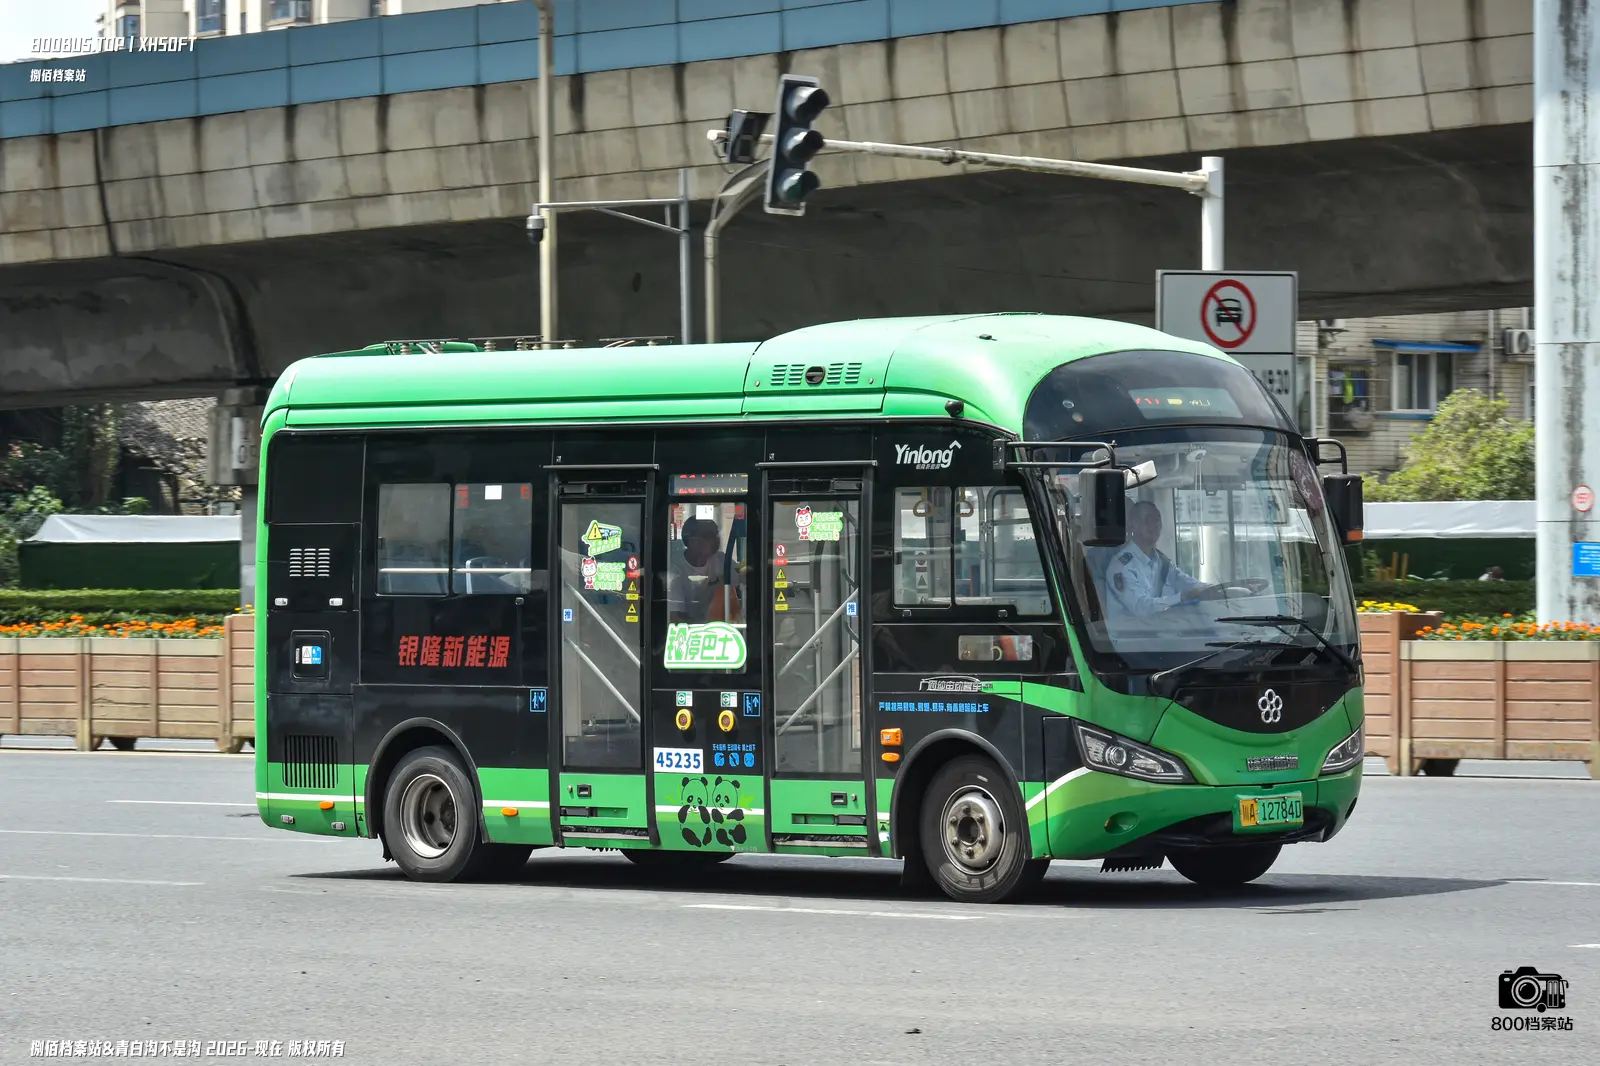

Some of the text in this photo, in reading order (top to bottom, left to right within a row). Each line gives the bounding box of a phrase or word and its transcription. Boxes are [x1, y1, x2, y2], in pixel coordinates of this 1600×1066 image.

[895, 444, 954, 469] Yinlong
[846, 602, 856, 615] 推
[398, 636, 511, 668] 银隆新能源
[656, 751, 702, 770] 45235
[1261, 800, 1302, 821] 12784D
